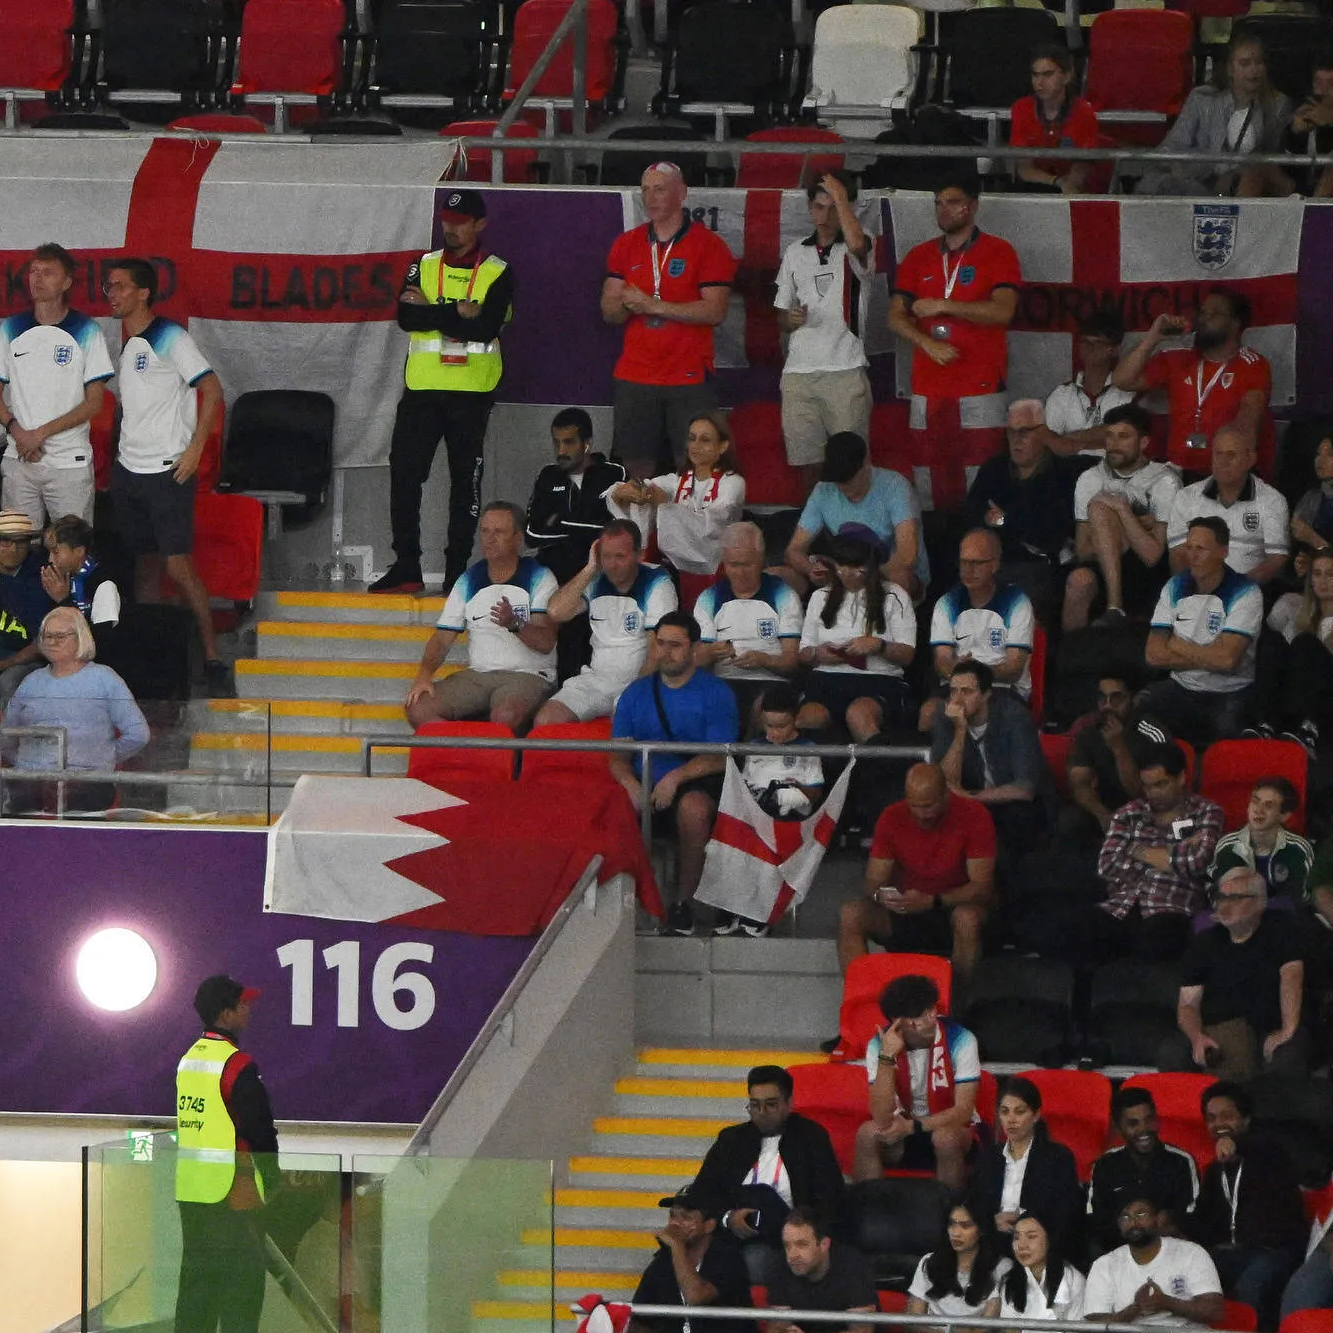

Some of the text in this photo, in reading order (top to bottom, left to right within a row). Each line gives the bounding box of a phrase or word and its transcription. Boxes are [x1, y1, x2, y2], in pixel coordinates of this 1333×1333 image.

[231, 263, 394, 311] BLADES
[276, 938, 435, 1032] 116
[179, 1094, 205, 1113] 3745
